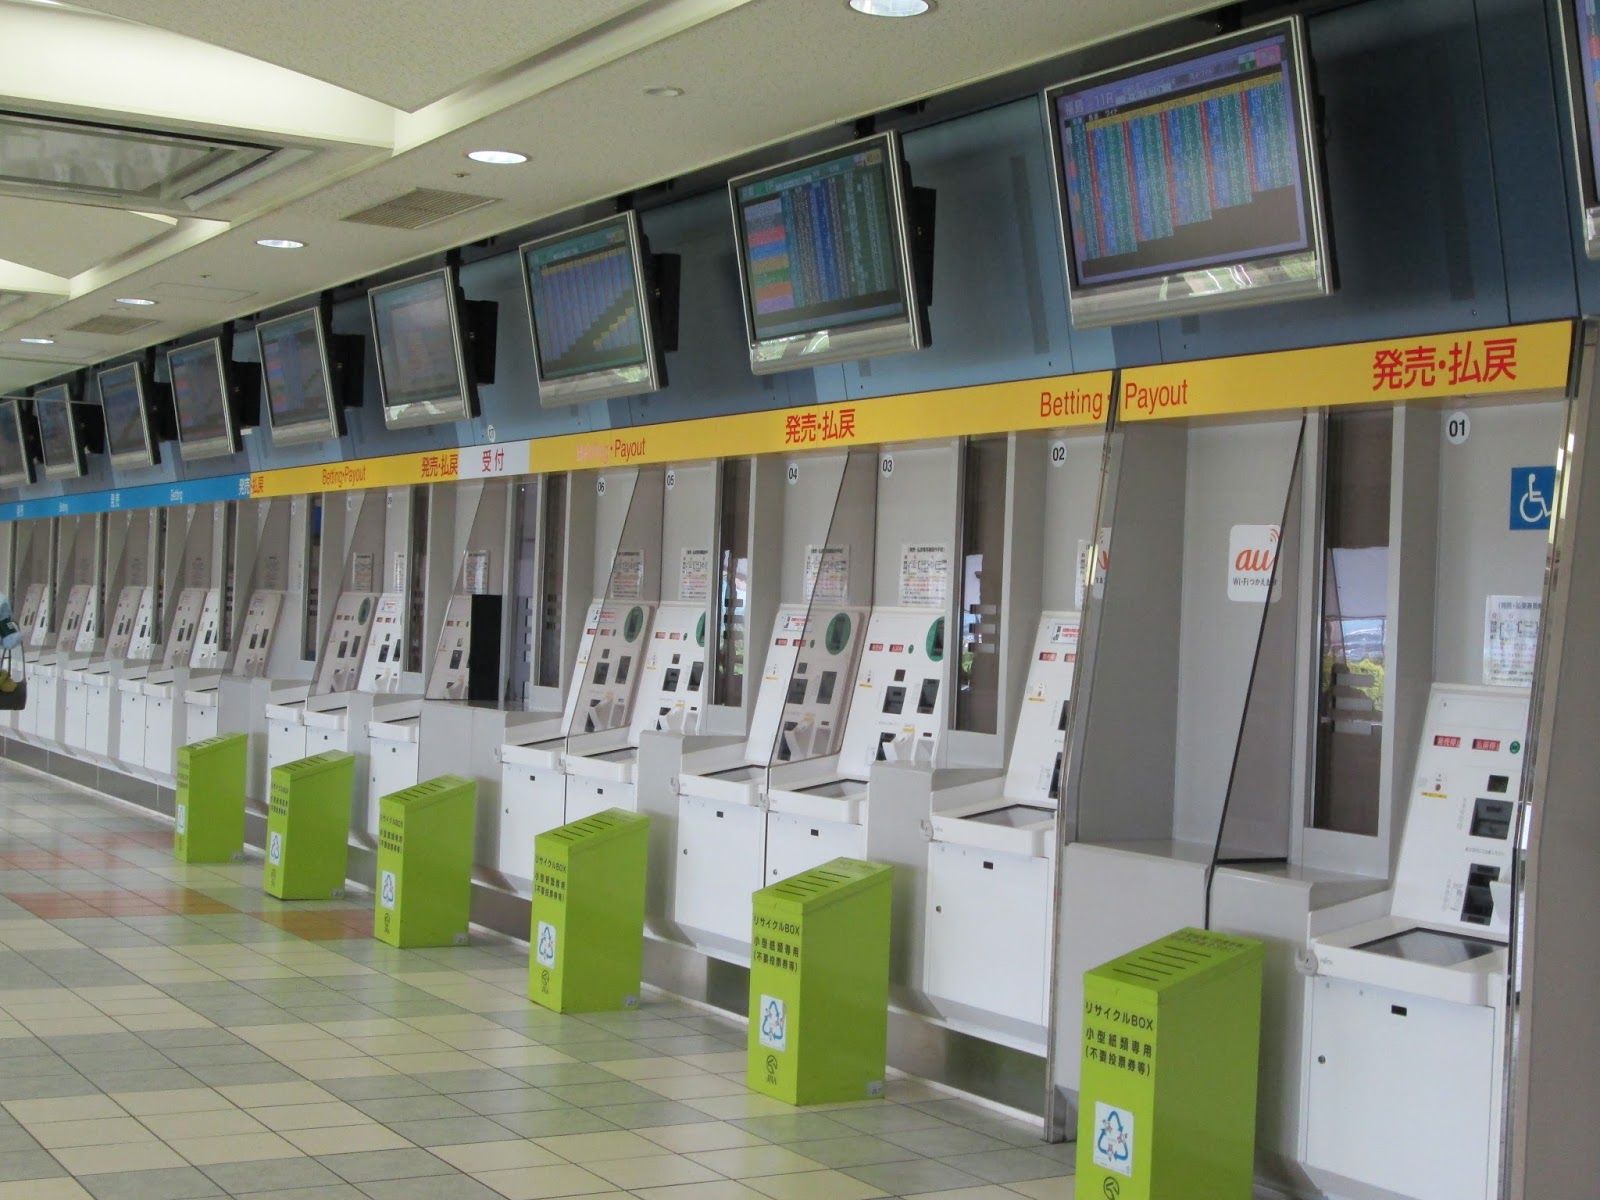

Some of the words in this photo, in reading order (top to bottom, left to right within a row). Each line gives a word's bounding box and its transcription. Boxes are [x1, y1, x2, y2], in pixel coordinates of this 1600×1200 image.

[1372, 338, 1517, 391] 発売・払戻
[785, 408, 856, 444] 発売・払戻
[1449, 419, 1465, 437] 01
[482, 448, 504, 472] 受付
[1052, 446, 1065, 461] 02
[421, 453, 458, 478] 発売・払戻
[788, 467, 798, 480] 04
[882, 459, 893, 472] 03
[597, 481, 605, 492] 06
[666, 474, 675, 486] 05
[1235, 549, 1275, 571] au
[754, 916, 800, 936] リサイクルBOX
[1085, 1001, 1153, 1031] リサイクルBOX
[1086, 1027, 1152, 1058] 小型紙類専用
[1085, 1045, 1151, 1077] (不要投票券等)
